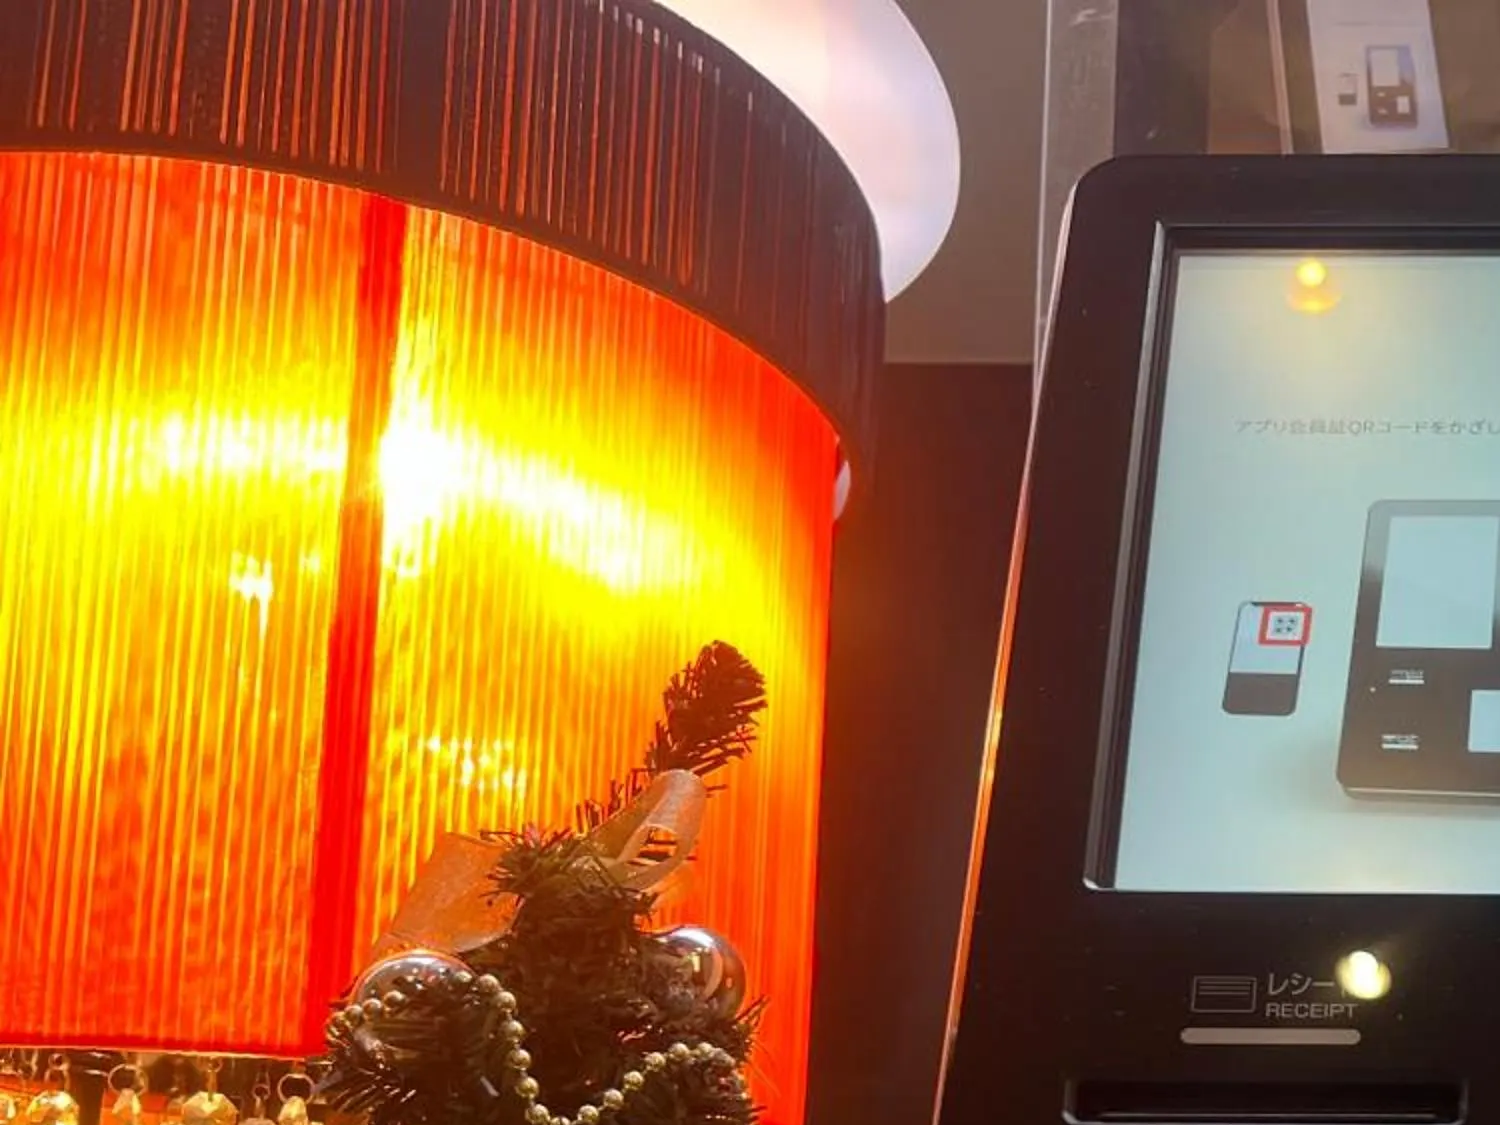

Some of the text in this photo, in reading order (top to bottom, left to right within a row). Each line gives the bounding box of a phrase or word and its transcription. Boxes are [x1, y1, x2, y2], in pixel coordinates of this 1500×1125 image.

[1267, 972, 1349, 997] レシー
[1265, 1002, 1358, 1019] RECEIPT
